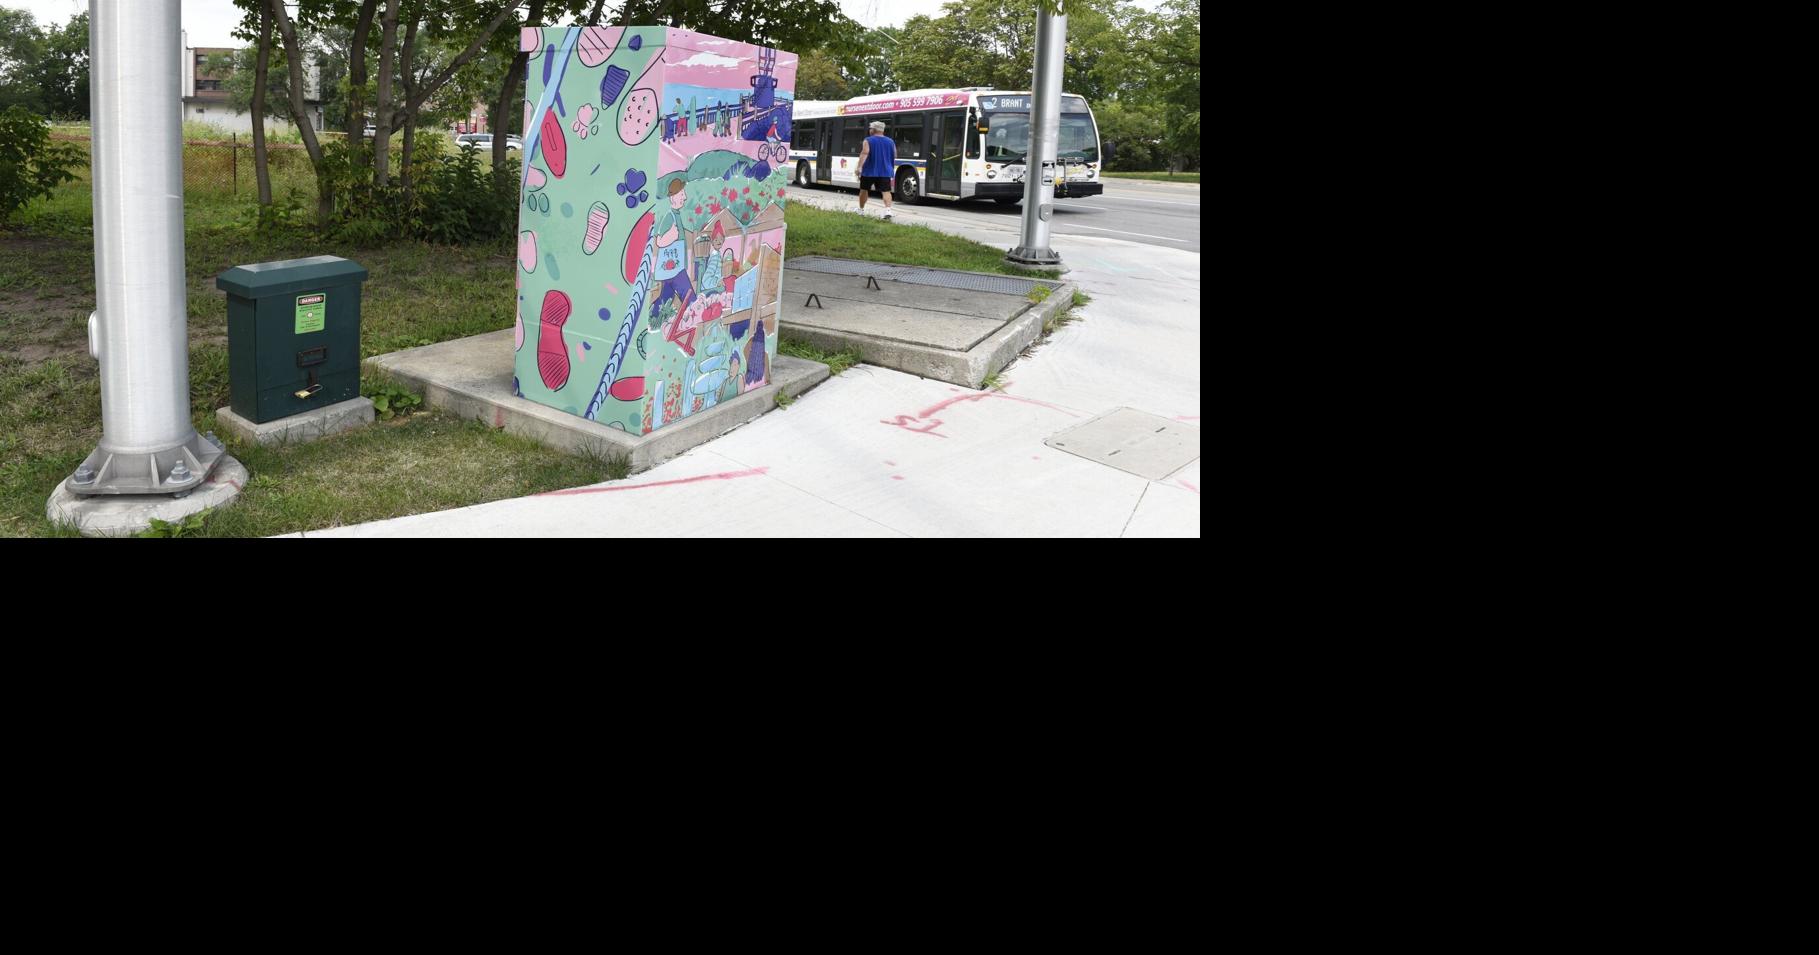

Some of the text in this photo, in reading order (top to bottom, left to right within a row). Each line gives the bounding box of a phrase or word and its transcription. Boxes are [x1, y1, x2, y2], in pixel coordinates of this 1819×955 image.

[899, 98, 911, 108] 905
[912, 97, 924, 107] 599
[926, 96, 943, 105] 7906
[1001, 98, 1023, 108] BRANT
